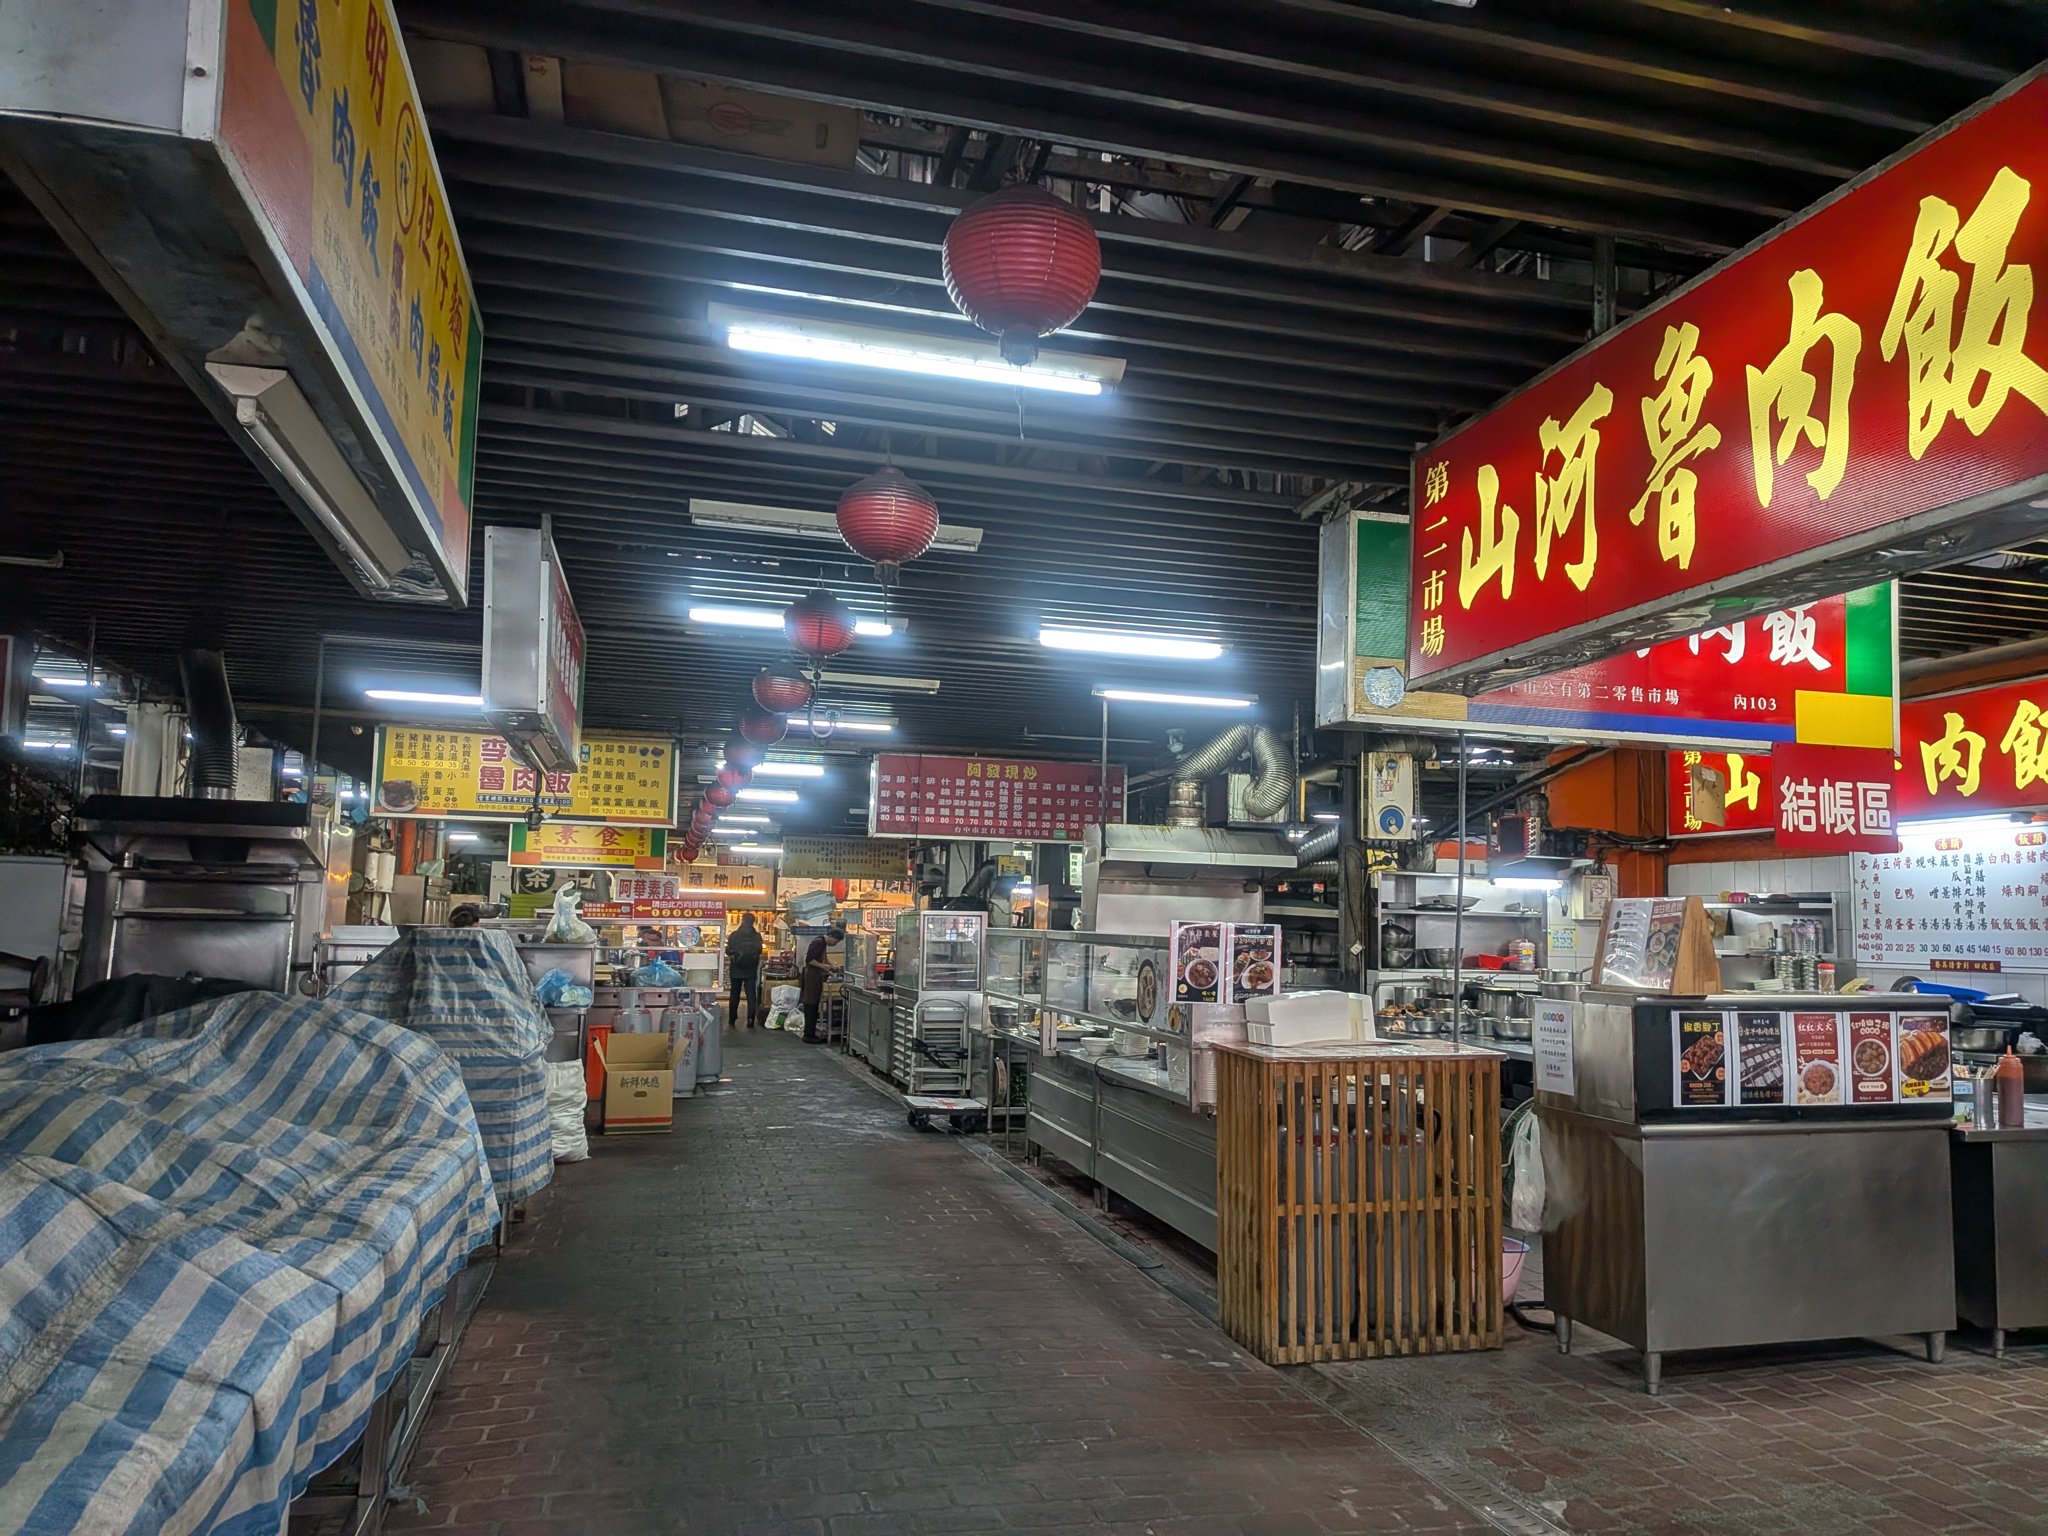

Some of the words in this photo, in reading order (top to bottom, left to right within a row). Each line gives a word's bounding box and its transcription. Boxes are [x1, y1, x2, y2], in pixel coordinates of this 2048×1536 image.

[1458, 166, 2048, 610] 山河魯肉飯
[1420, 460, 1449, 659] 第二市場
[1634, 601, 1832, 671] 肉飯
[1508, 680, 1680, 706] 中市公有第二零售市場
[1734, 694, 1778, 711] 內103
[434, 760, 444, 768] 50
[967, 763, 1038, 780] 阿發現炒
[478, 765, 572, 794] 魯肉飯
[895, 775, 906, 815] 排骨飯
[1780, 775, 1893, 836] 結帳區
[984, 818, 993, 826] 80
[555, 826, 624, 846] 素食
[618, 879, 676, 899] 阿華素食
[1859, 859, 1871, 930] 各式青菜
[1871, 857, 1882, 930] 扁魚白菜魯
[1883, 858, 1893, 930] 豆腐
[1893, 857, 1904, 930] 荷包蛋
[1904, 857, 1915, 930] 魯鴨蛋
[1951, 854, 1963, 931] 苦瓜排骨湯
[1975, 853, 1988, 931] 藥膳排骨湯
[1988, 853, 2001, 931] 白飯
[2000, 852, 2014, 931] 肉燥飯
[2013, 851, 2027, 931] 魯肉飯
[1861, 943, 1870, 951] 40
[1874, 943, 1883, 951] 60
[1895, 944, 1904, 952] 20
[1906, 944, 1915, 952] 25
[1919, 944, 1928, 952] 30
[1931, 944, 1940, 952] 30
[1942, 944, 1951, 952] 60
[1955, 944, 1964, 954] 45
[1966, 944, 1975, 954] 45
[1978, 943, 1990, 954] 140
[1992, 944, 2001, 954] 15
[2005, 946, 2014, 955] 60
[2017, 946, 2026, 956] 80
[2029, 947, 2042, 956] 130
[1874, 953, 1883, 961] 30
[619, 1075, 661, 1089] 新鮮供應
